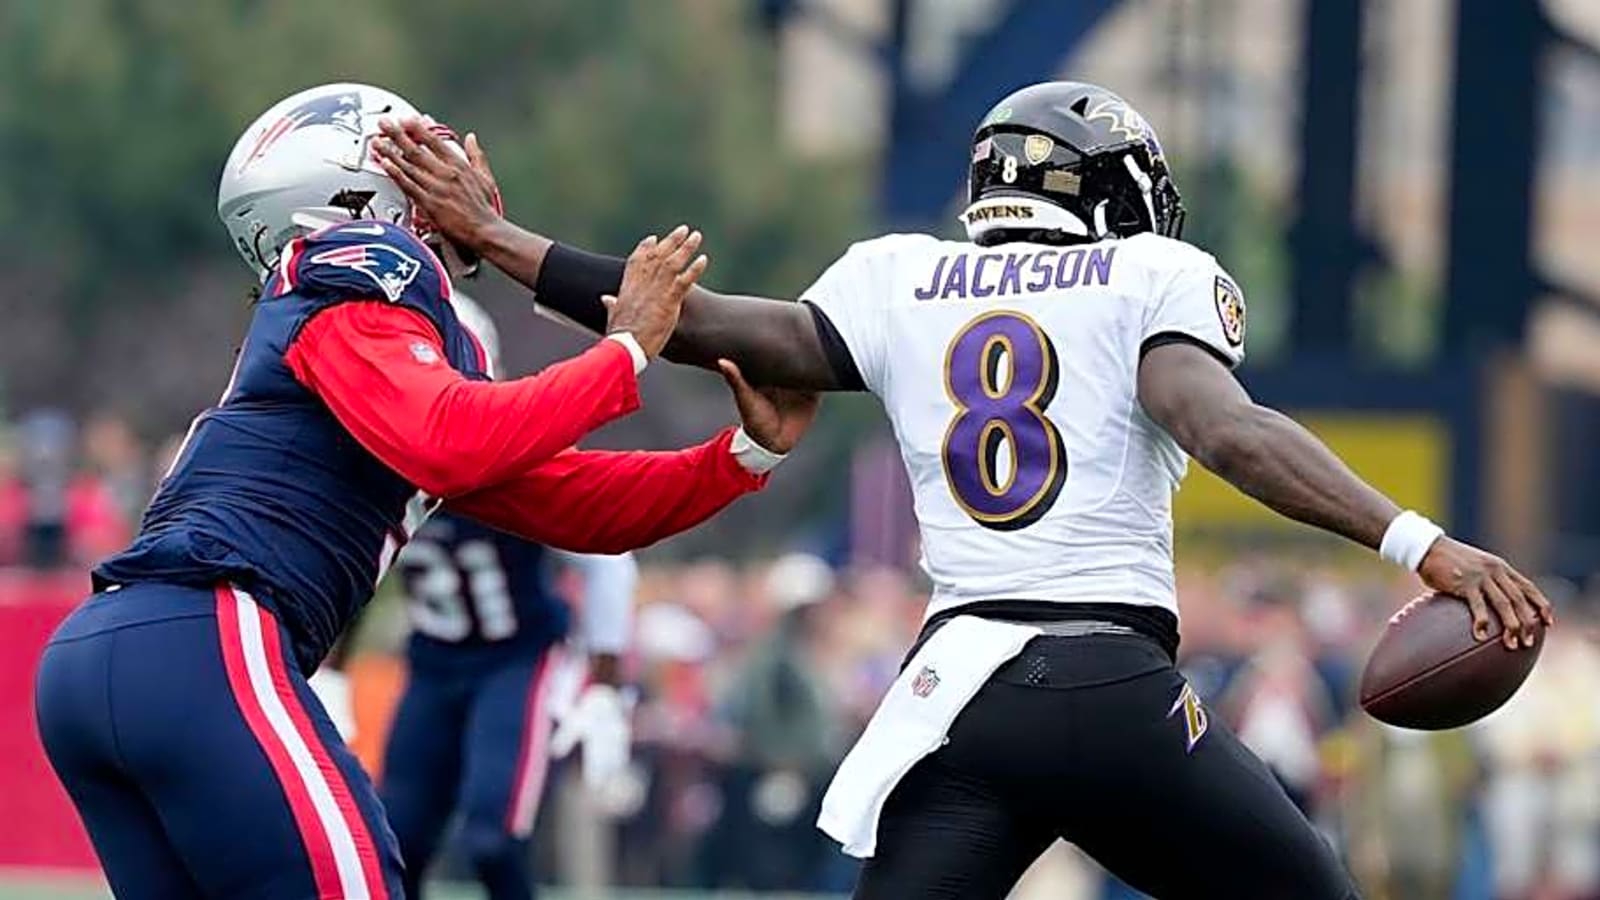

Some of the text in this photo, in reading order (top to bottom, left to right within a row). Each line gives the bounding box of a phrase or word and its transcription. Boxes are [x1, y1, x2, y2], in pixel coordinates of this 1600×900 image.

[1002, 156, 1018, 183] 8
[967, 205, 1034, 225] RAVENS
[914, 247, 1117, 301] JACKSON
[941, 309, 1068, 532] 8
[403, 539, 519, 643] 31
